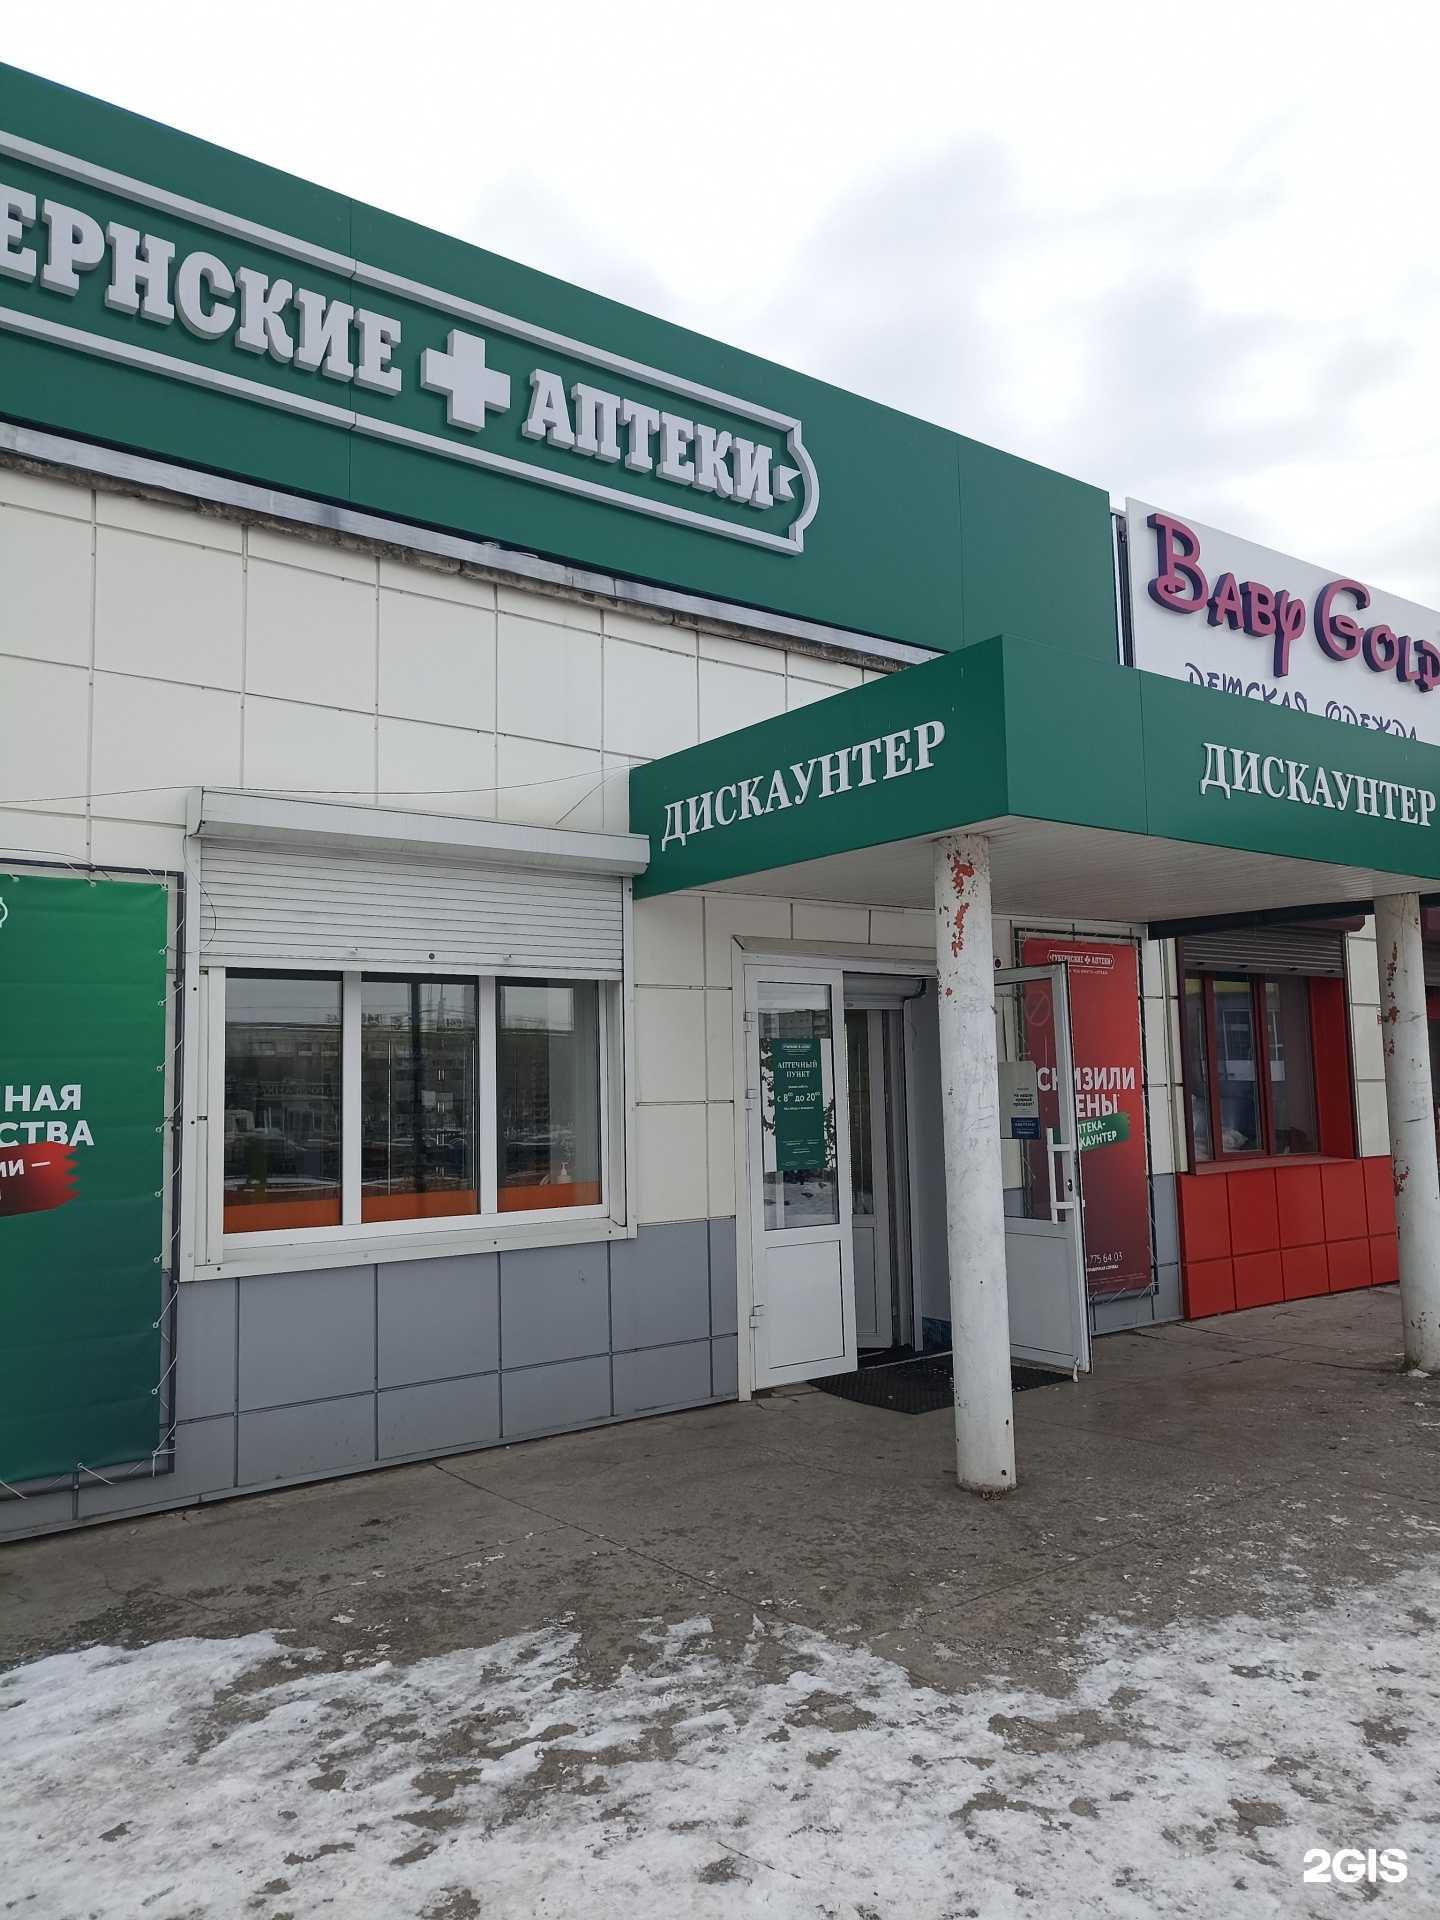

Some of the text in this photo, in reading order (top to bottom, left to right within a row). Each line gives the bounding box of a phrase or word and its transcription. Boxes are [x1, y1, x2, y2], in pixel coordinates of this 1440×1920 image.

[522, 368, 775, 510] АПТЕКИ
[661, 720, 946, 852] ДИСКАУНТЕР
[1200, 742, 1436, 827] ДИСКАУНТЕР
[4, 1084, 82, 1112] НАЯ
